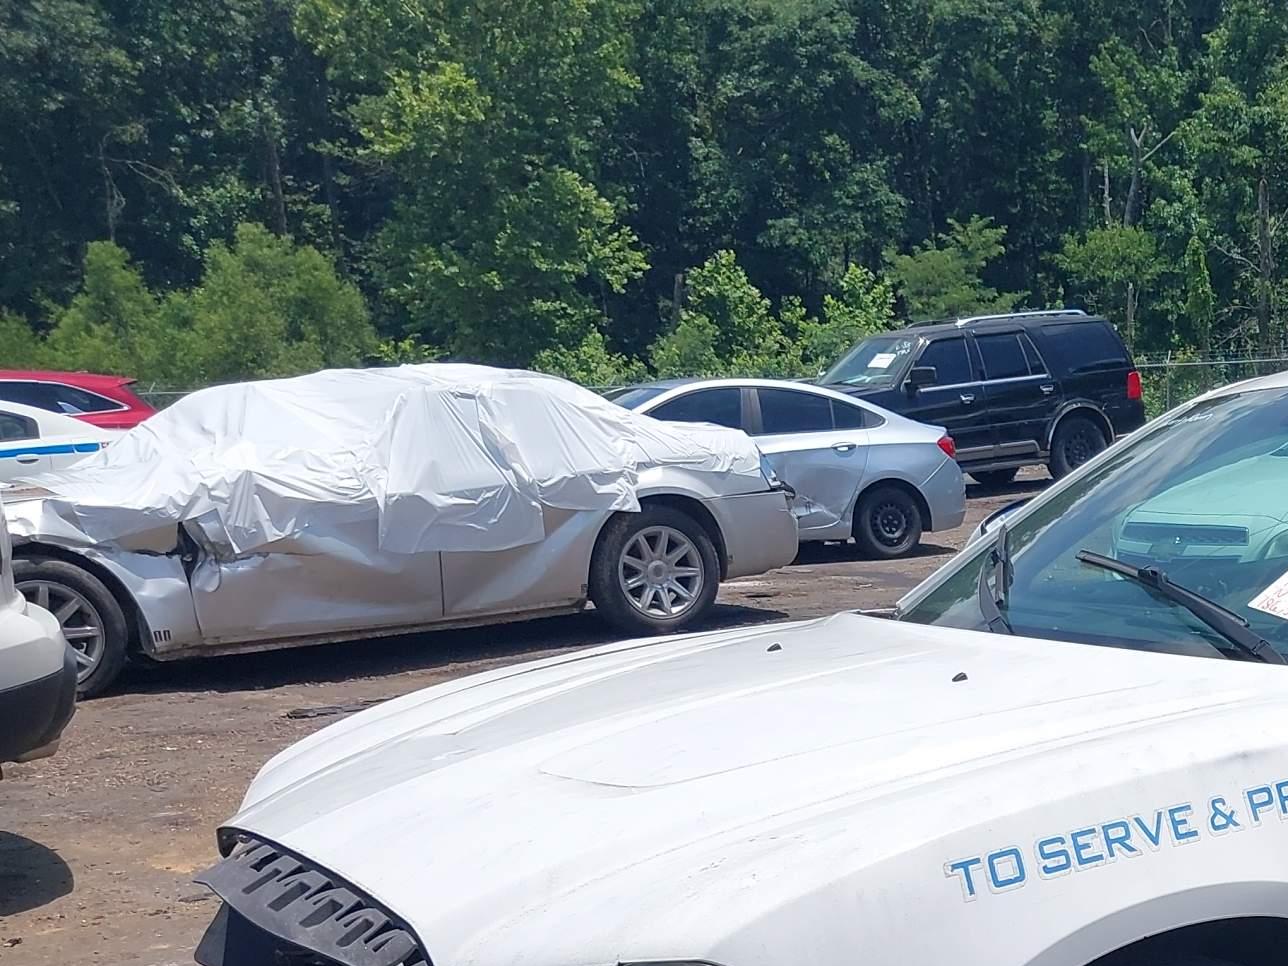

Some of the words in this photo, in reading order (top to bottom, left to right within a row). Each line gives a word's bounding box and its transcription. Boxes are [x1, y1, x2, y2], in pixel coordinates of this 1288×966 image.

[945, 846, 1028, 900] TO
[1037, 802, 1200, 878] SERVE
[1208, 797, 1241, 834] &
